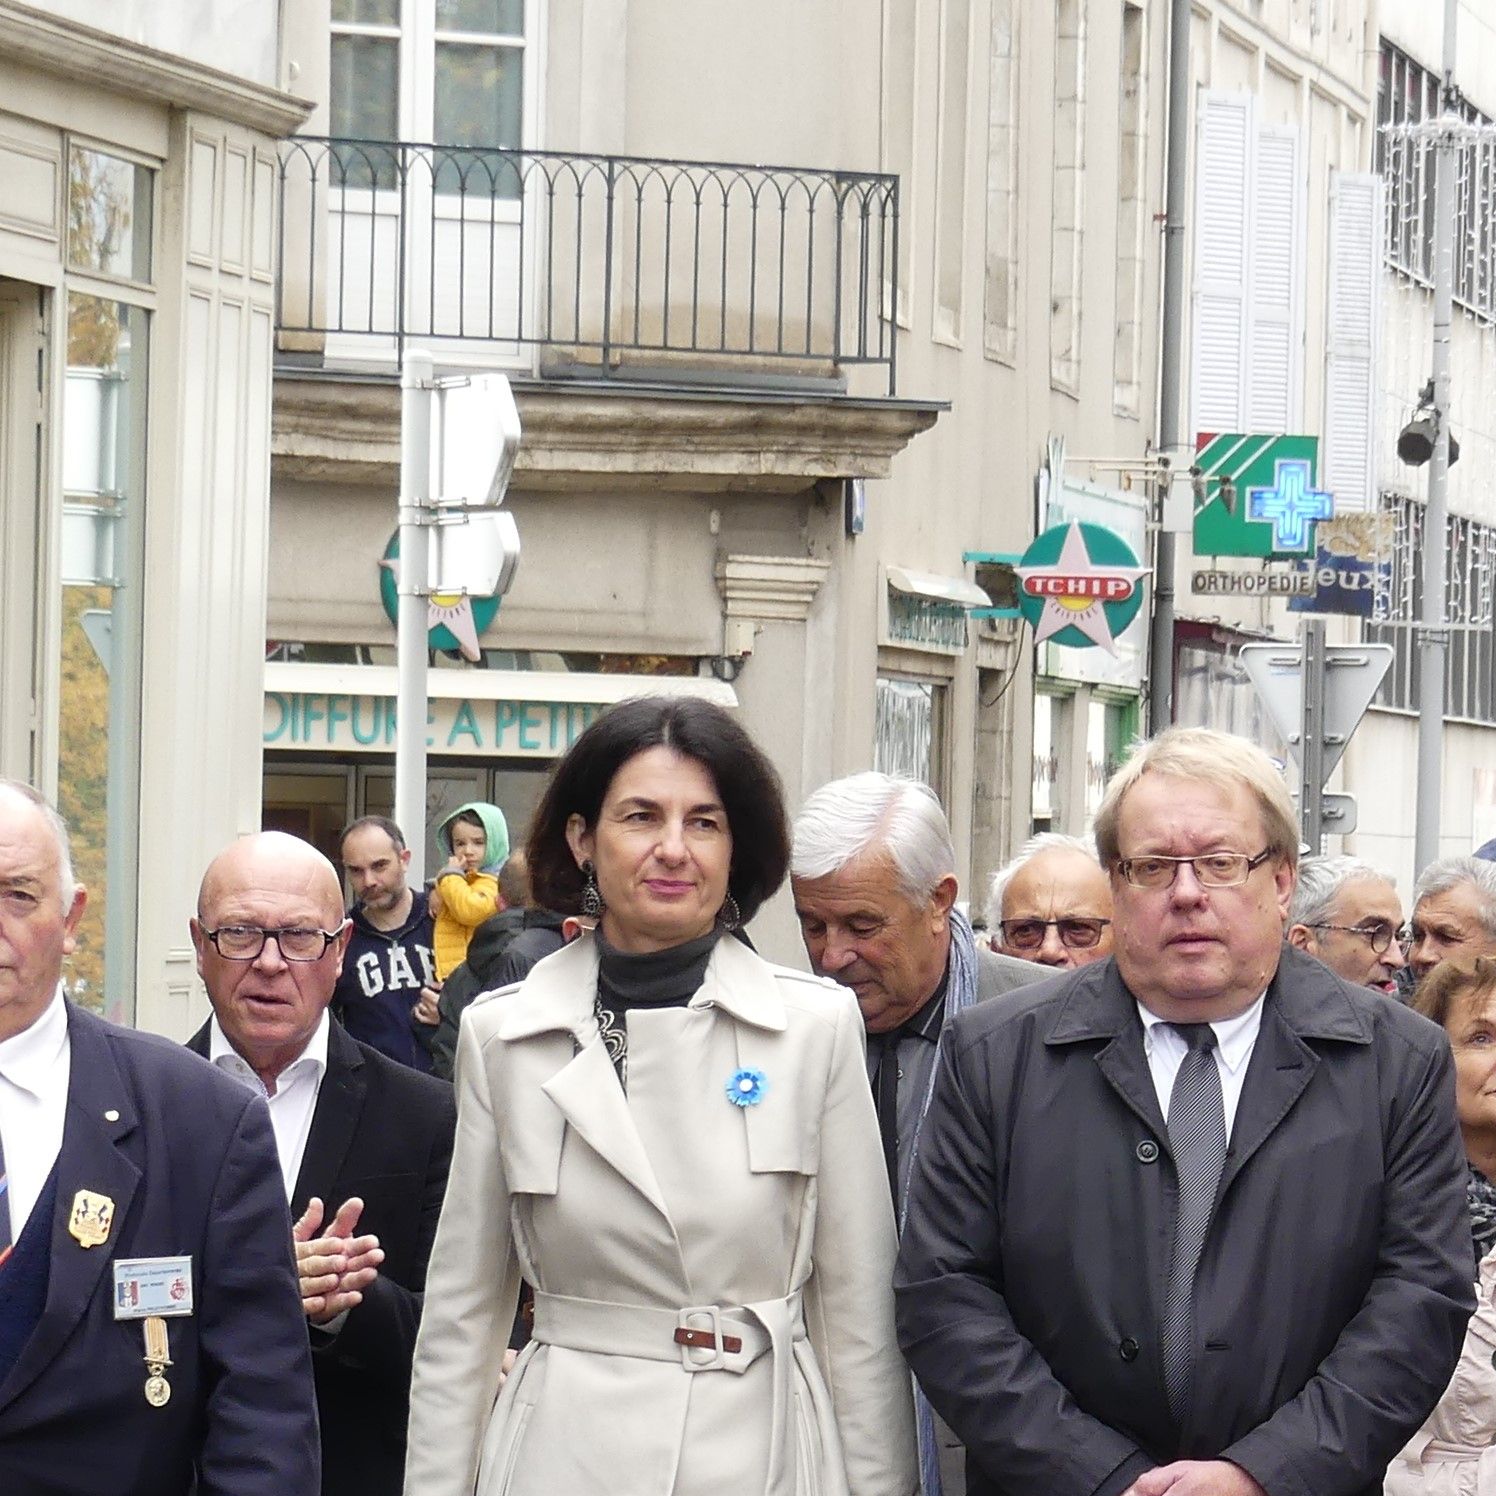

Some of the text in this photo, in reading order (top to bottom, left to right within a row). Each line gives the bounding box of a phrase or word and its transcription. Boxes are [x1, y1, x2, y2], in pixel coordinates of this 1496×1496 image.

[1031, 578, 1129, 596] TCHIP
[1194, 572, 1310, 593] ORTHOPEDIE
[447, 698, 484, 748] A
